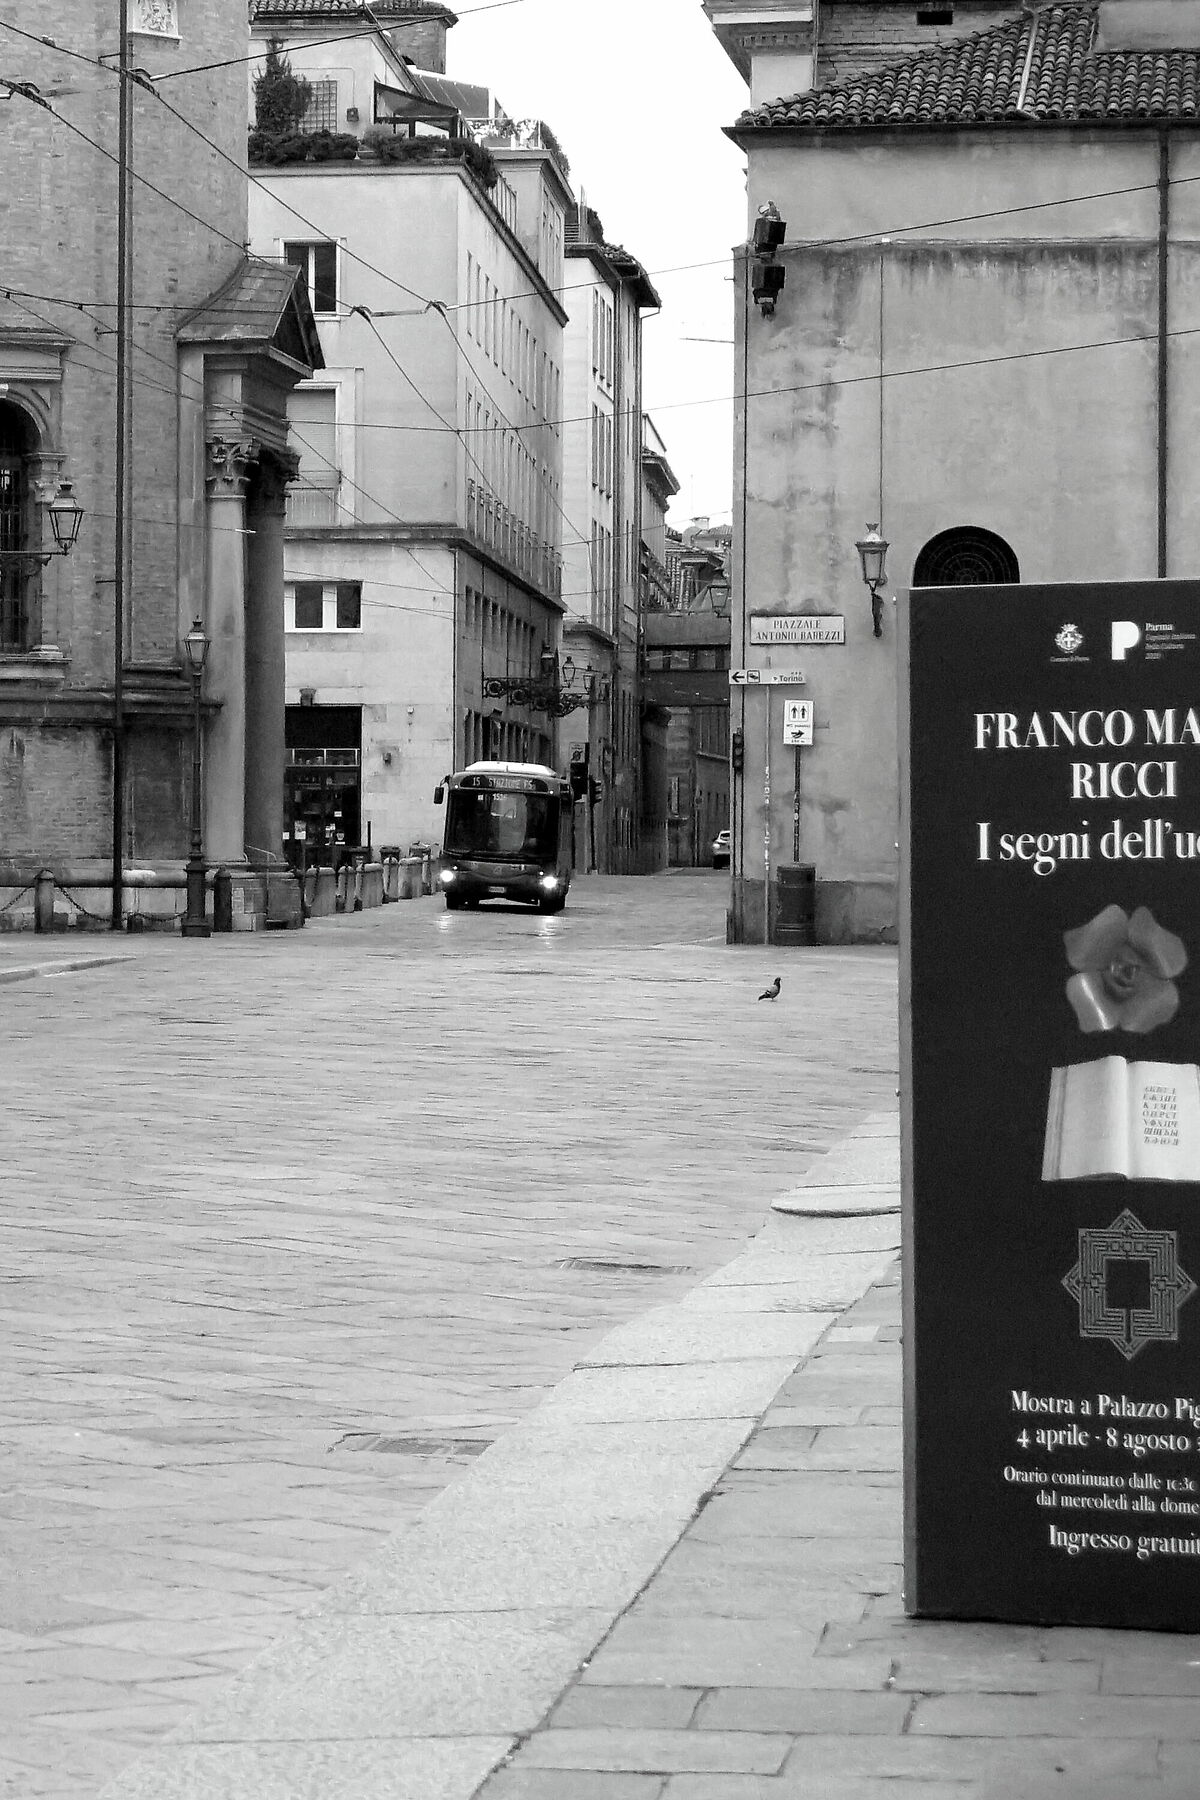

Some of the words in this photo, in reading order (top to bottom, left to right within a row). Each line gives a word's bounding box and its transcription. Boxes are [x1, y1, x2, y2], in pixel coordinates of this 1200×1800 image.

[756, 631, 797, 641] ANTONIO
[800, 631, 841, 641] BAREZZI
[773, 619, 821, 630] PIAZZALE
[1145, 622, 1174, 631] Parma
[973, 709, 1135, 749] FRANCO
[473, 777, 480, 786] 15
[1069, 761, 1177, 799] RICCI
[976, 822, 991, 860] I
[999, 819, 1091, 876] segni
[1100, 818, 1200, 859] dell'u
[1011, 1390, 1075, 1415] Mostra
[1080, 1400, 1091, 1415] a
[1098, 1394, 1169, 1418] Palazzo
[1017, 1428, 1031, 1448] 4
[1036, 1424, 1090, 1451] aprile
[1106, 1427, 1118, 1447] 8
[1123, 1432, 1190, 1457] agosto
[1003, 1465, 1048, 1484] Orario
[1051, 1468, 1125, 1488] continuato
[1128, 1472, 1161, 1490] dalle
[1036, 1490, 1057, 1507] dal
[1132, 1495, 1156, 1512] alla
[1050, 1524, 1131, 1556] Ingresso
